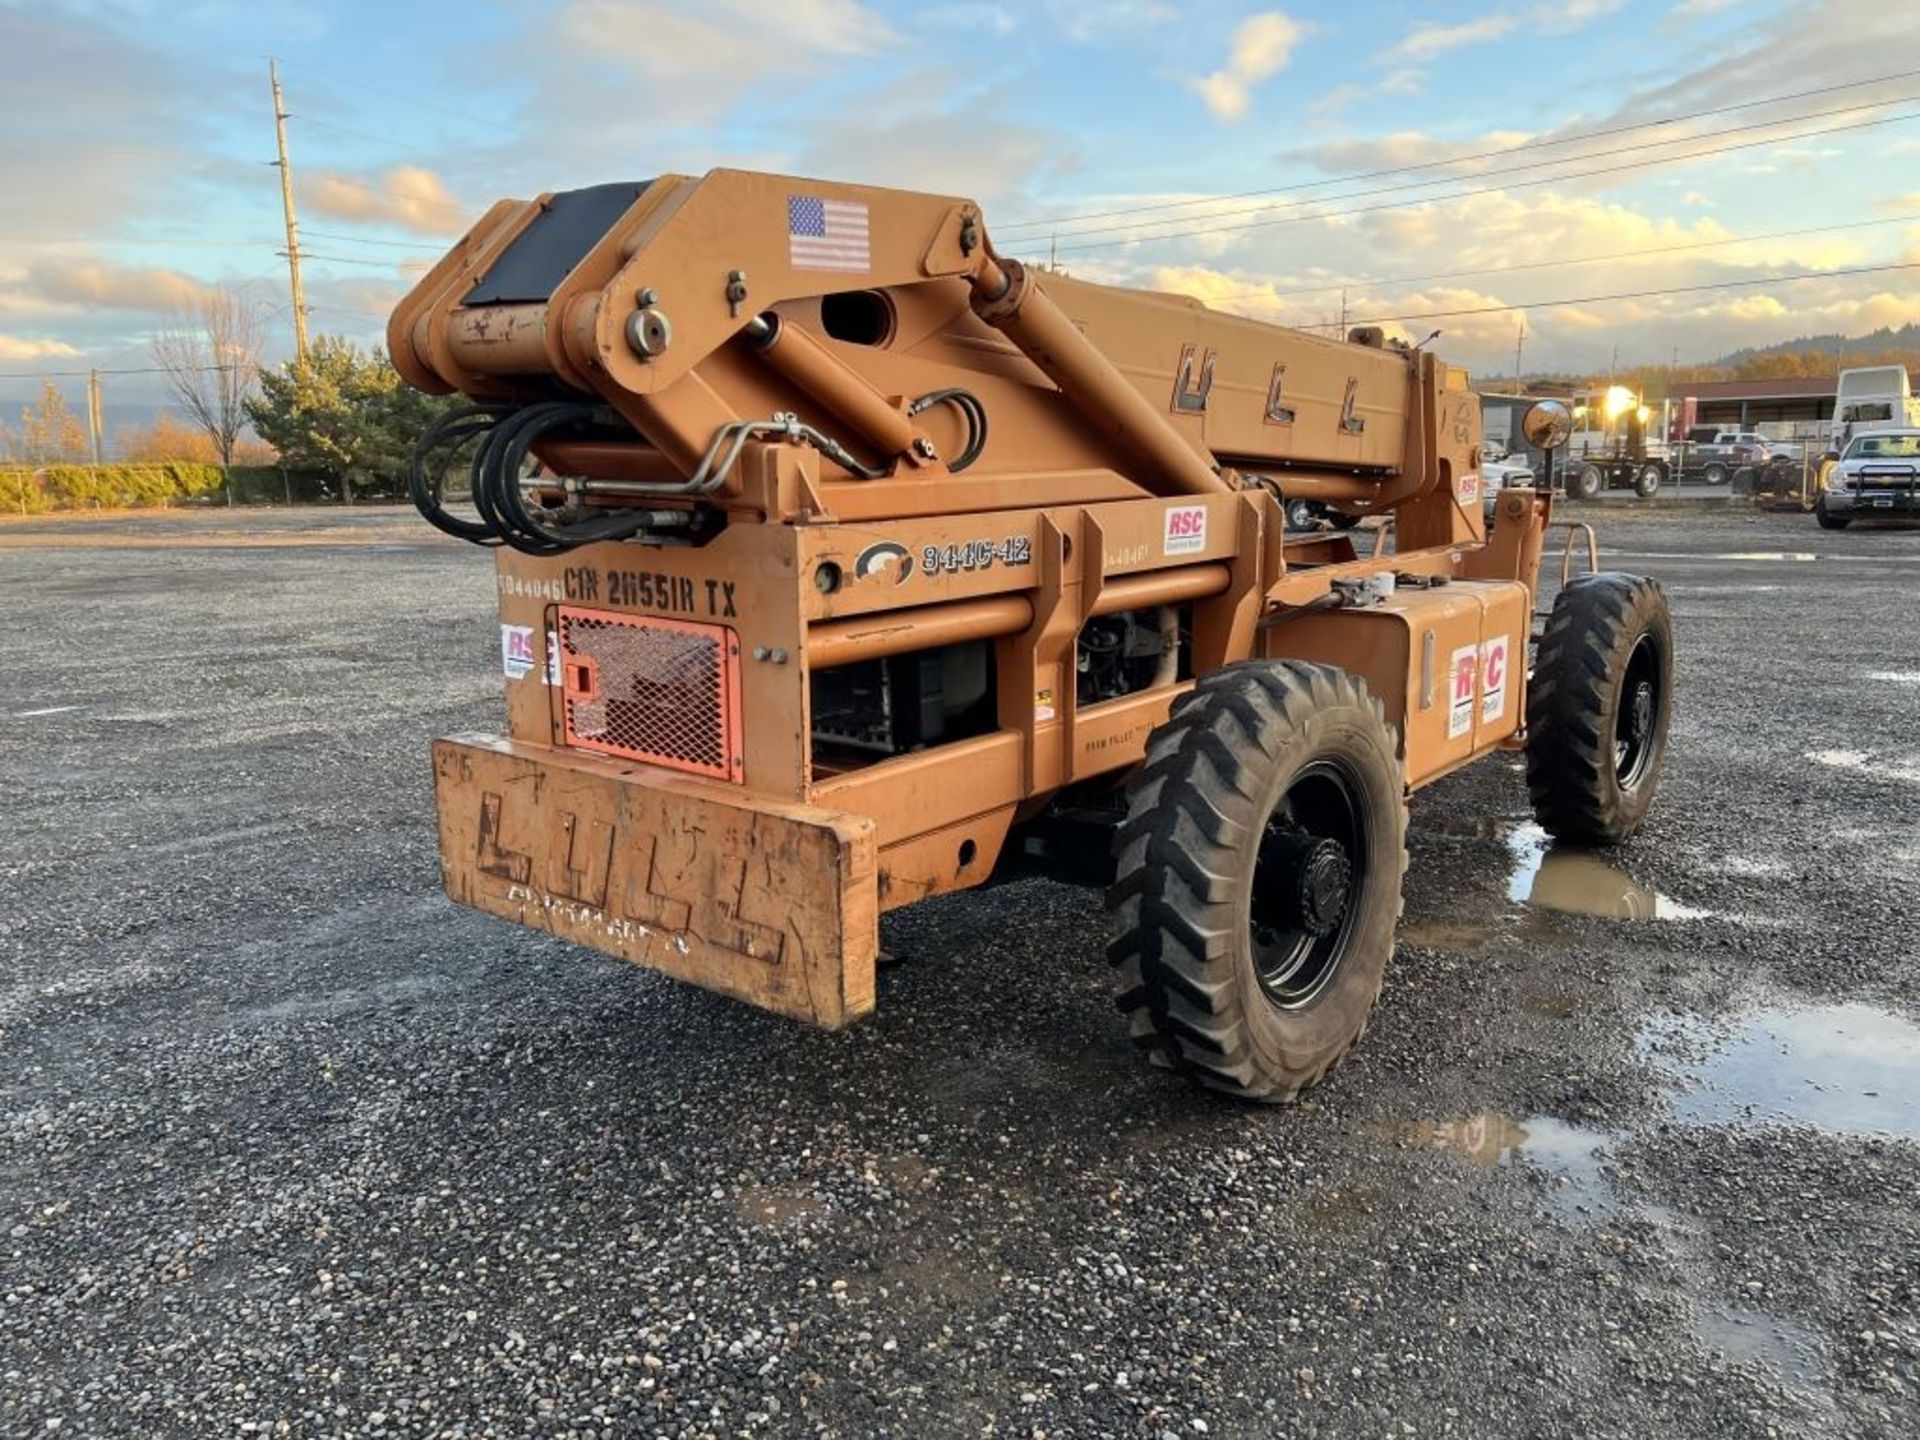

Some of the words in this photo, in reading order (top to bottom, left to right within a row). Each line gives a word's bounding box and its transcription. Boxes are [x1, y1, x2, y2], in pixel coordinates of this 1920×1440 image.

[1171, 343, 1365, 437] ULL
[1169, 511, 1203, 535] RSC
[705, 579, 736, 618] TX
[1456, 645, 1504, 700] RC
[475, 790, 785, 966] LULL
